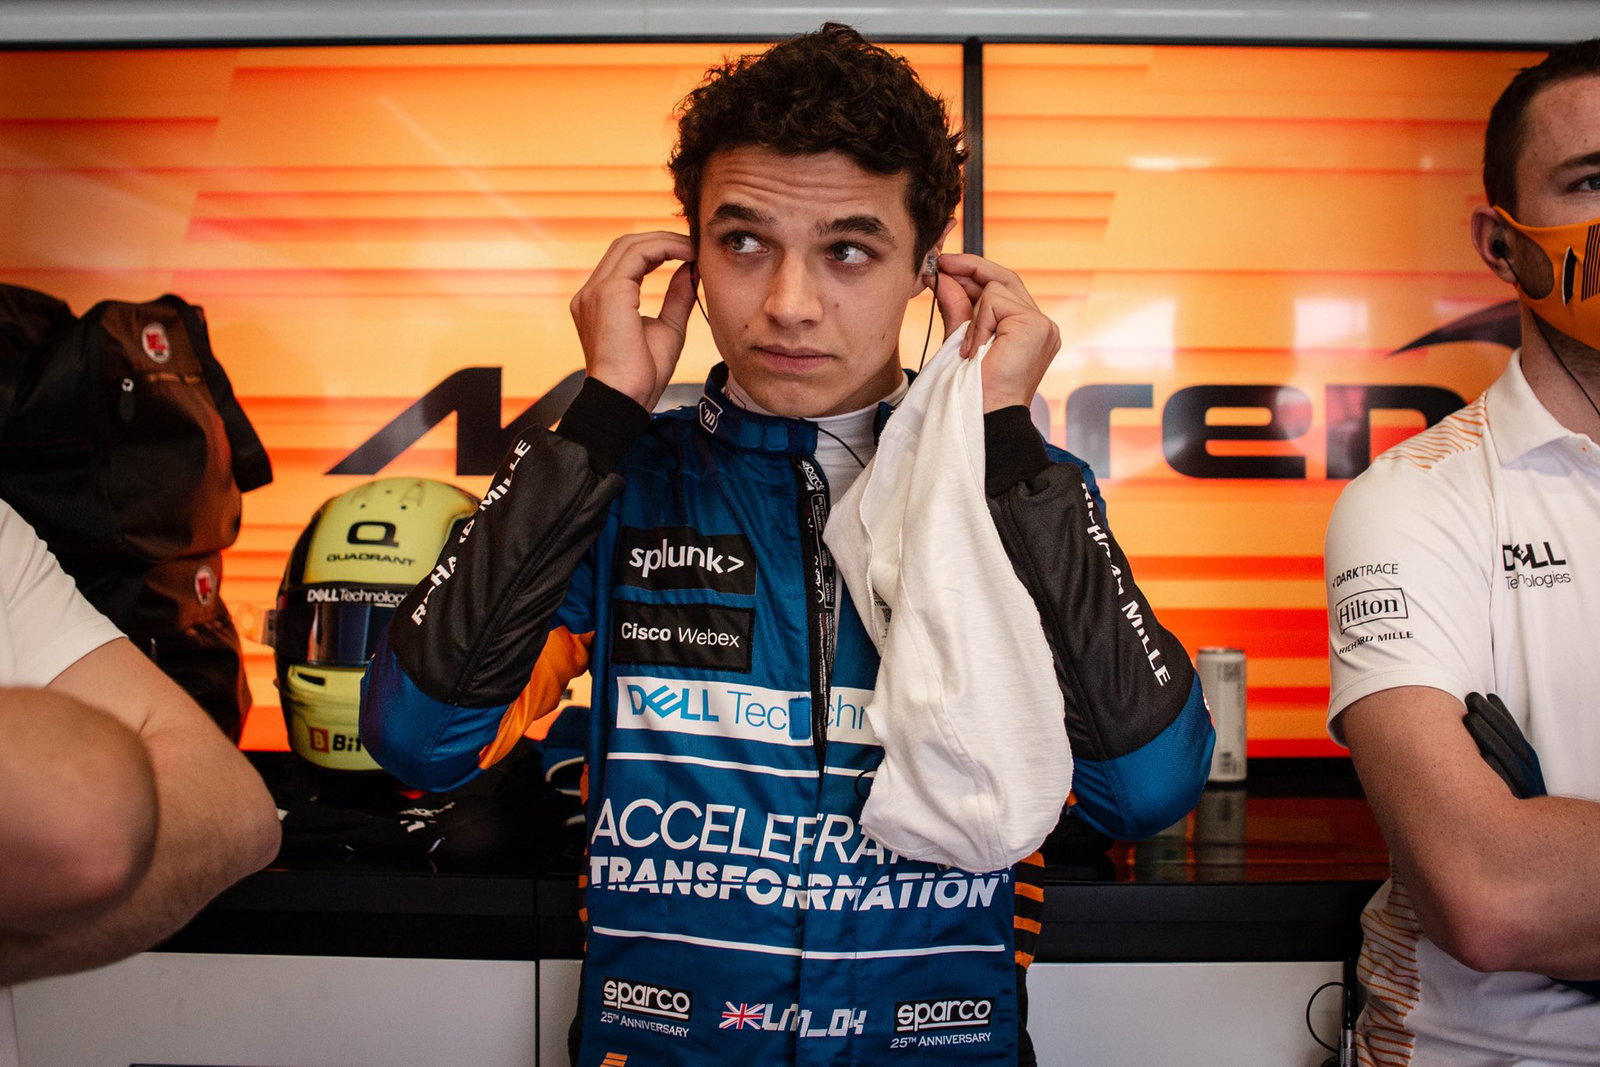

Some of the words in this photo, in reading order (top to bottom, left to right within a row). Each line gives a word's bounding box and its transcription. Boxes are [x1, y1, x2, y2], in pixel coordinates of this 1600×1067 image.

[347, 521, 399, 548] Q
[326, 553, 416, 567] QUADRANT
[1502, 541, 1567, 571] DELL
[1336, 563, 1399, 588] DARKTRACE
[306, 588, 340, 602] DELL
[339, 587, 408, 607] Technolog
[1339, 598, 1399, 626] Hilton
[621, 622, 671, 642] Cisco
[677, 626, 740, 647] Webex
[1377, 631, 1414, 642] MILLE
[627, 684, 720, 723] DELL
[603, 980, 690, 1010] sparco
[620, 1015, 690, 1038] ANNIVERSARY
[897, 999, 992, 1032] sparco
[918, 1032, 992, 1047] ANNIVERSARY
